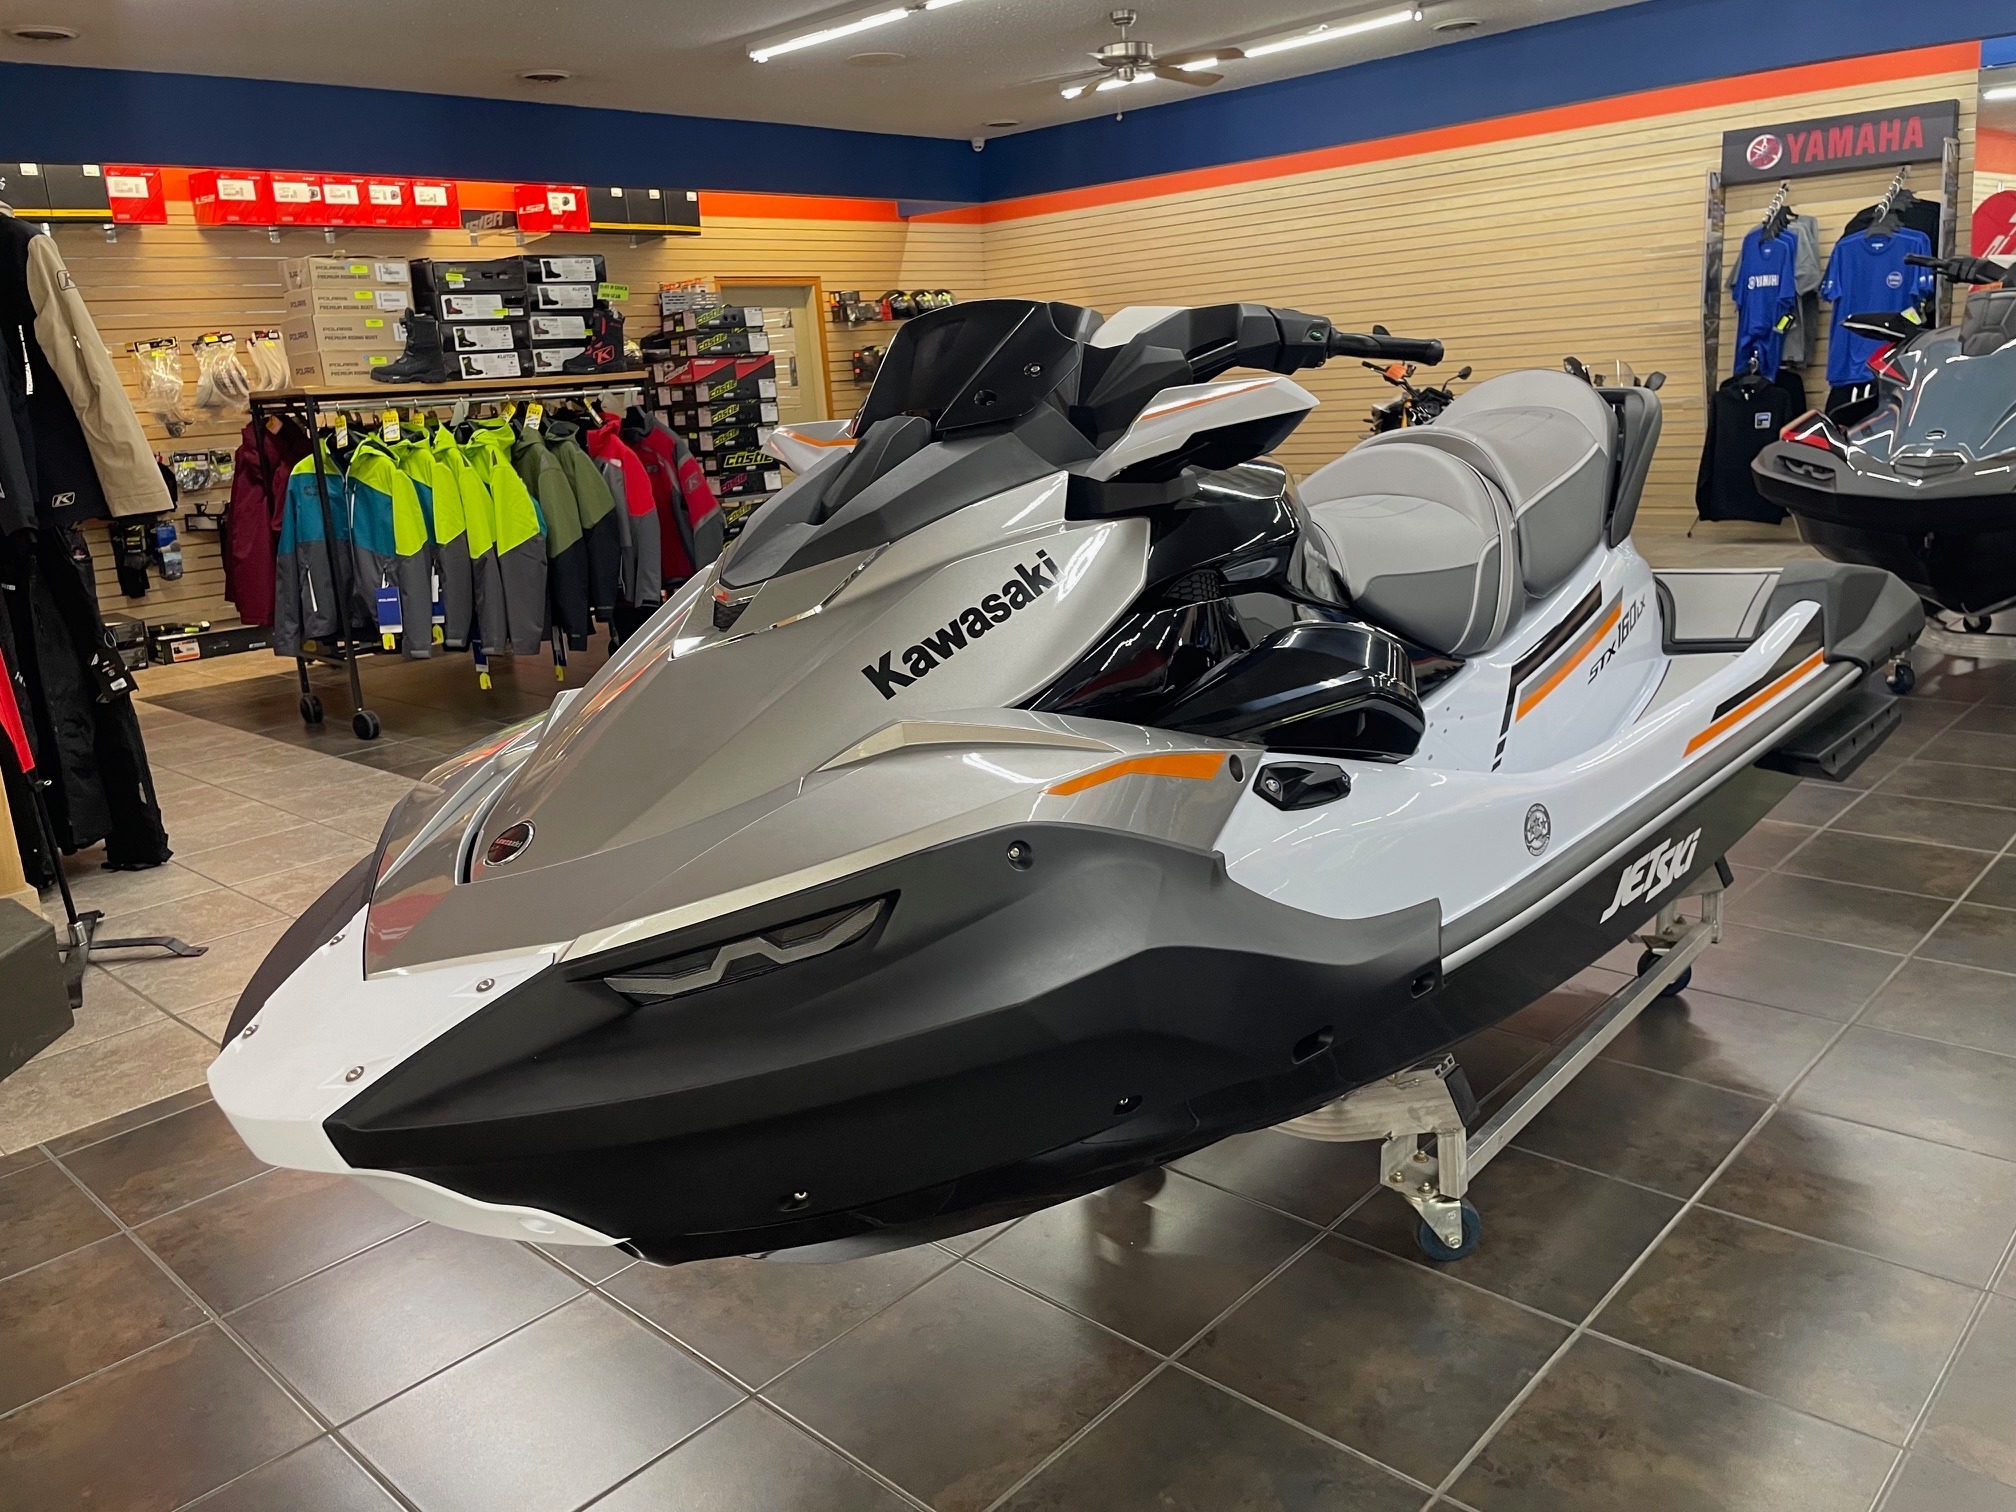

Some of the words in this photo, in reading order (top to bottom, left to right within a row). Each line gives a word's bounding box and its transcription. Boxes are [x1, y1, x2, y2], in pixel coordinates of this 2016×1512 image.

[1785, 115, 1924, 165] YAMAHA
[519, 203, 546, 215] LS2
[861, 548, 1065, 701] Kawasaki
[1587, 639, 1617, 686] STX
